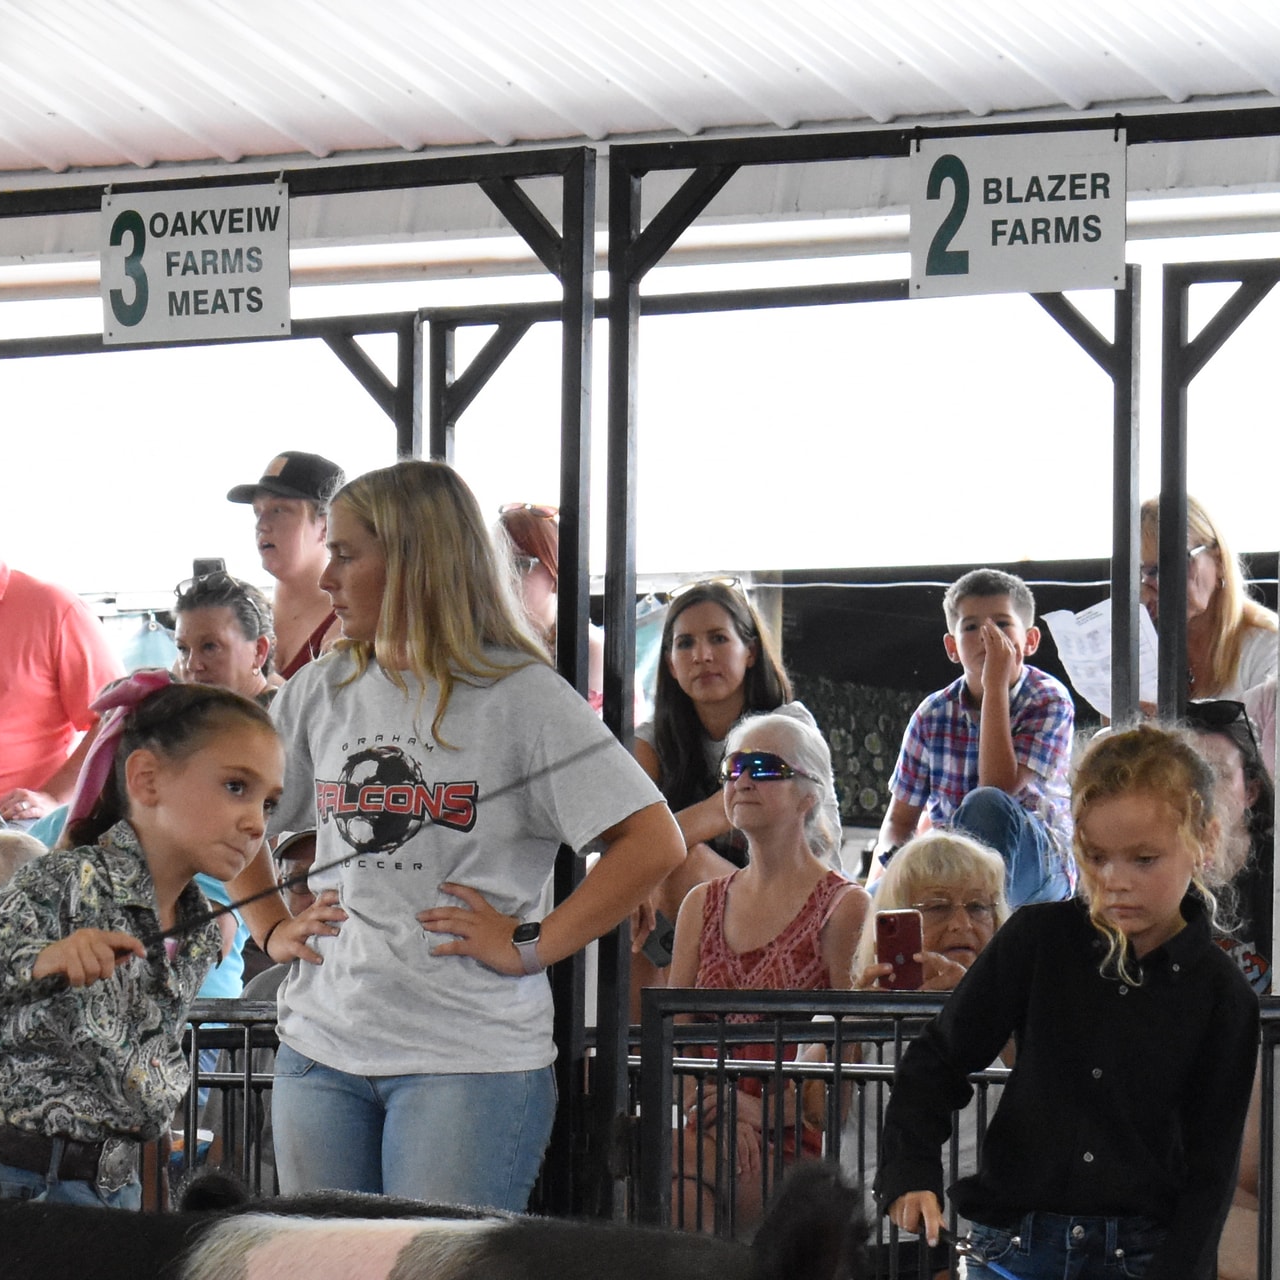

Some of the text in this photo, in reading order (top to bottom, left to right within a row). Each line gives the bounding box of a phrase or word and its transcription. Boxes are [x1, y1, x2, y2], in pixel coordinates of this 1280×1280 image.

[983, 172, 1110, 204] BLAZER
[149, 206, 281, 239] OAKVEIW
[925, 153, 970, 276] 2
[991, 214, 1102, 246] FARMS
[109, 209, 149, 327] 3
[166, 246, 263, 277] FARMS
[168, 286, 263, 317] MEATS
[341, 734, 434, 752] GRAHAM
[315, 779, 480, 833] FALCONS
